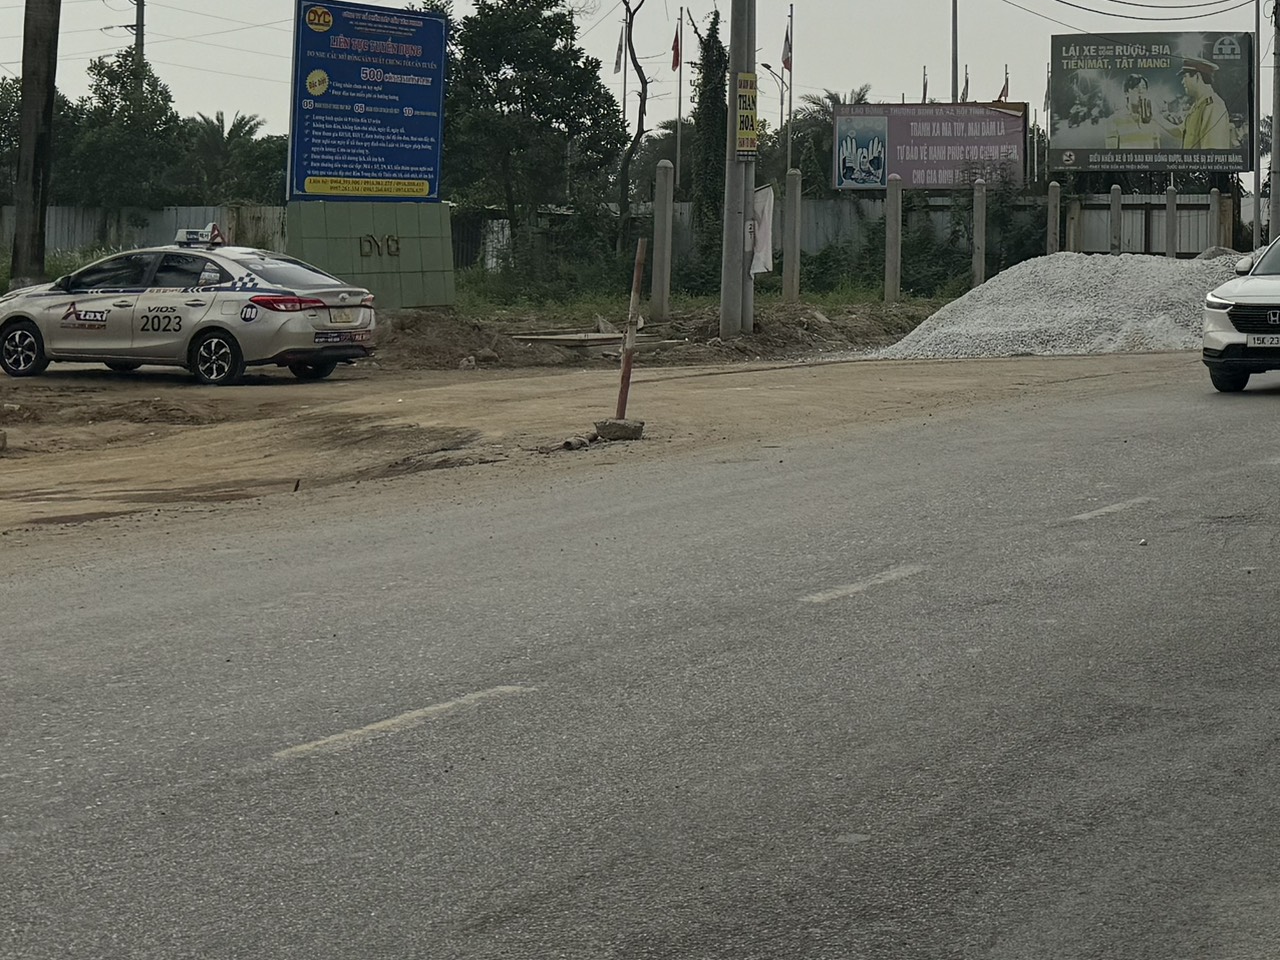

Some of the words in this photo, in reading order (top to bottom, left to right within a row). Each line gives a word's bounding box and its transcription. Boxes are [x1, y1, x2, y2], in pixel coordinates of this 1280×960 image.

[1062, 43, 1079, 56] LÁI
[1083, 45, 1097, 55] XE
[1152, 44, 1170, 55] BIA
[1138, 58, 1170, 68] MANG!
[361, 67, 383, 82] 500
[140, 315, 182, 332] 2023
